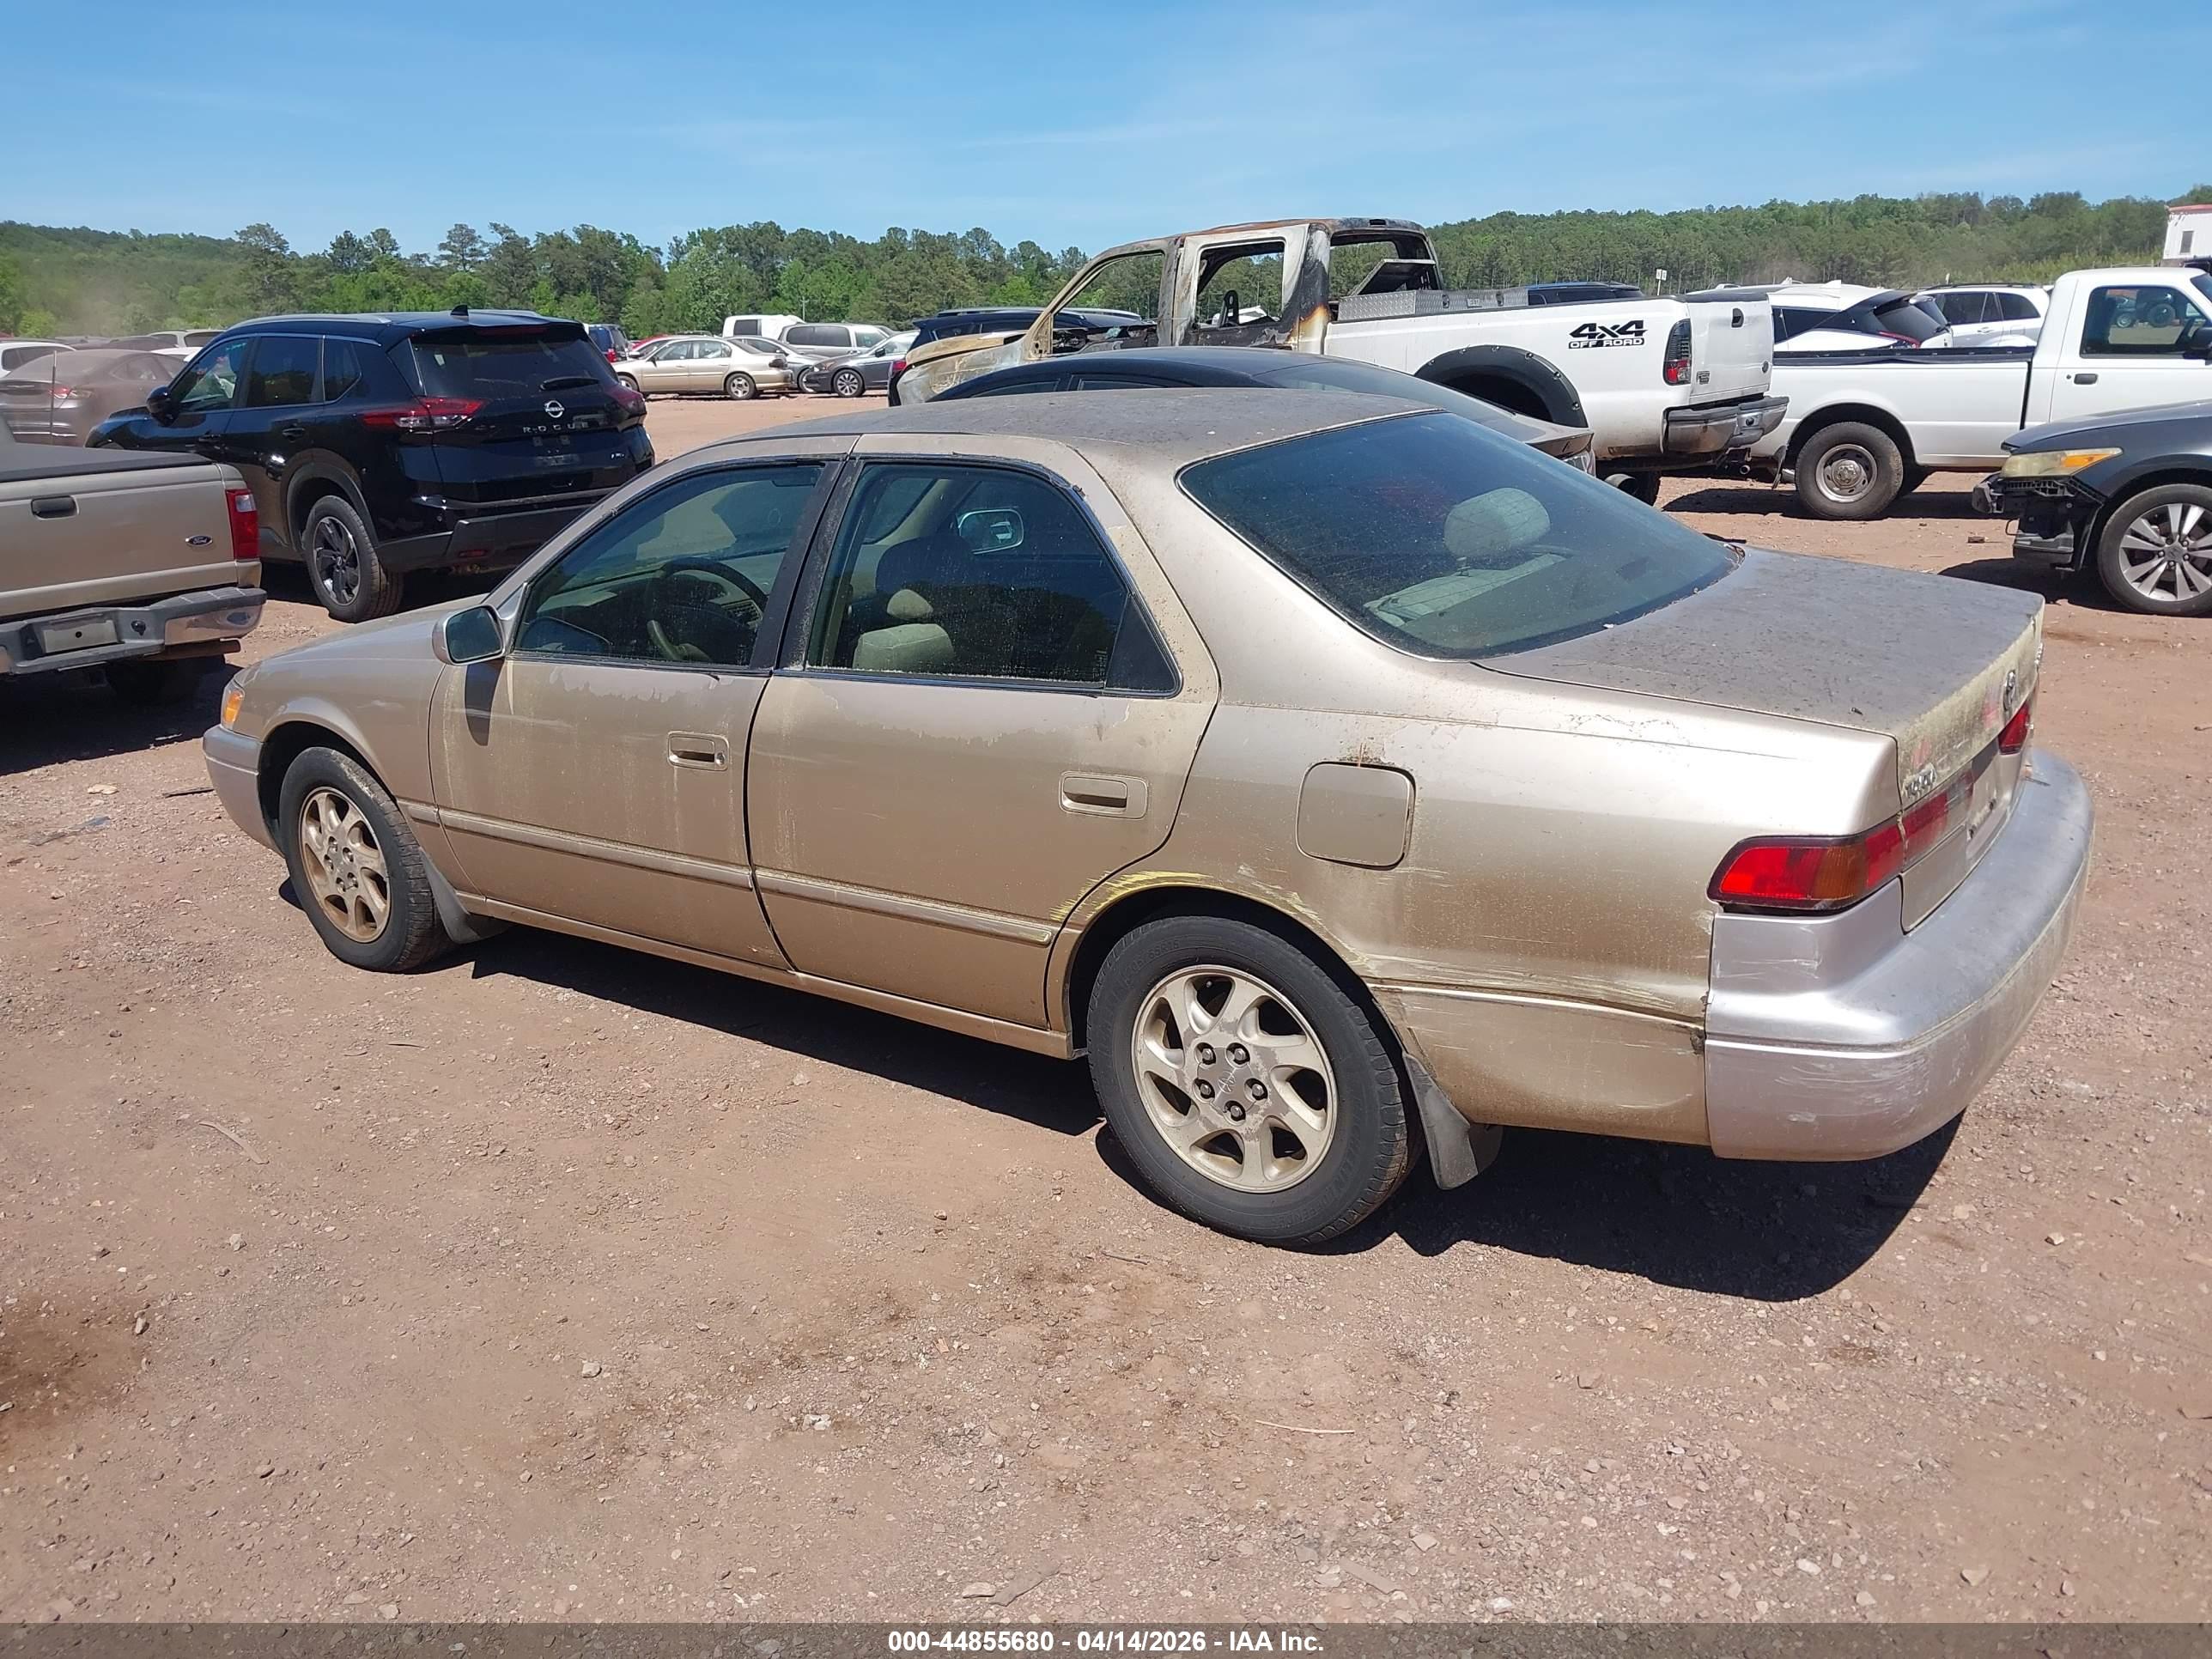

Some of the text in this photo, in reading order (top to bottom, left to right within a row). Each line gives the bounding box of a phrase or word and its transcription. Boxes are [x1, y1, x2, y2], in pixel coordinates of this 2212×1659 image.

[1570, 337, 1644, 349] OFF ROAD
[523, 422, 589, 433] ROGUE
